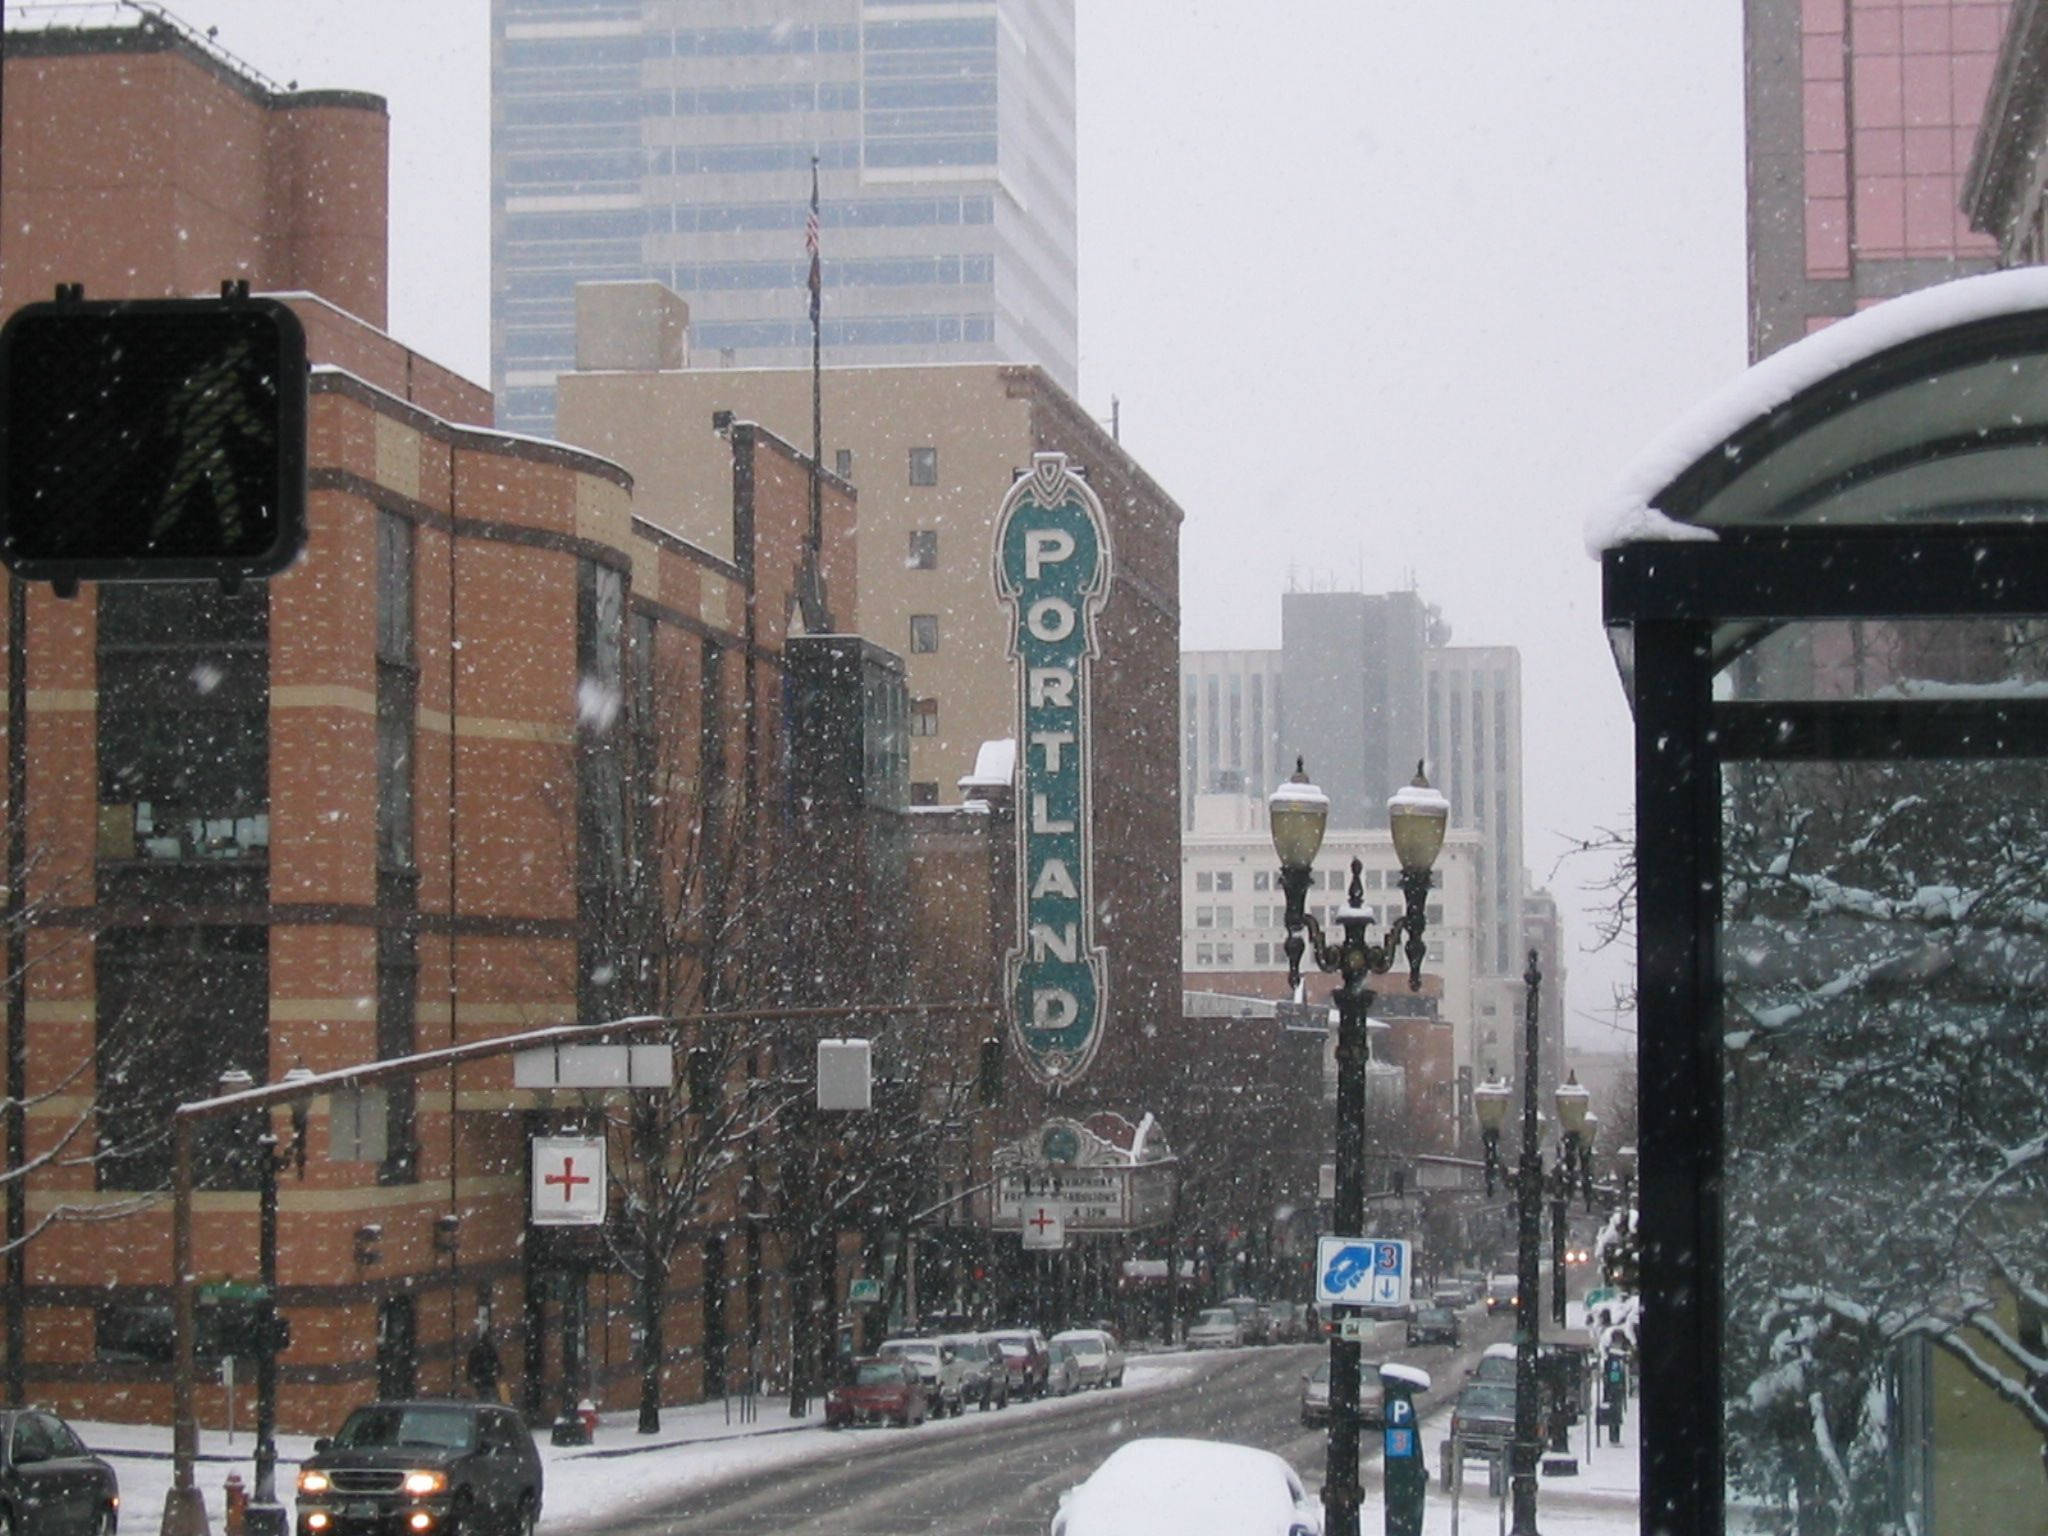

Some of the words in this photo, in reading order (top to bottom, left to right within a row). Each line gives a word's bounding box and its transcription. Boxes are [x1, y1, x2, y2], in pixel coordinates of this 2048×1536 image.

[1024, 528, 1079, 1029] PORTLAND
[1381, 1246, 1396, 1270] 3
[1394, 1400, 1409, 1423] P
